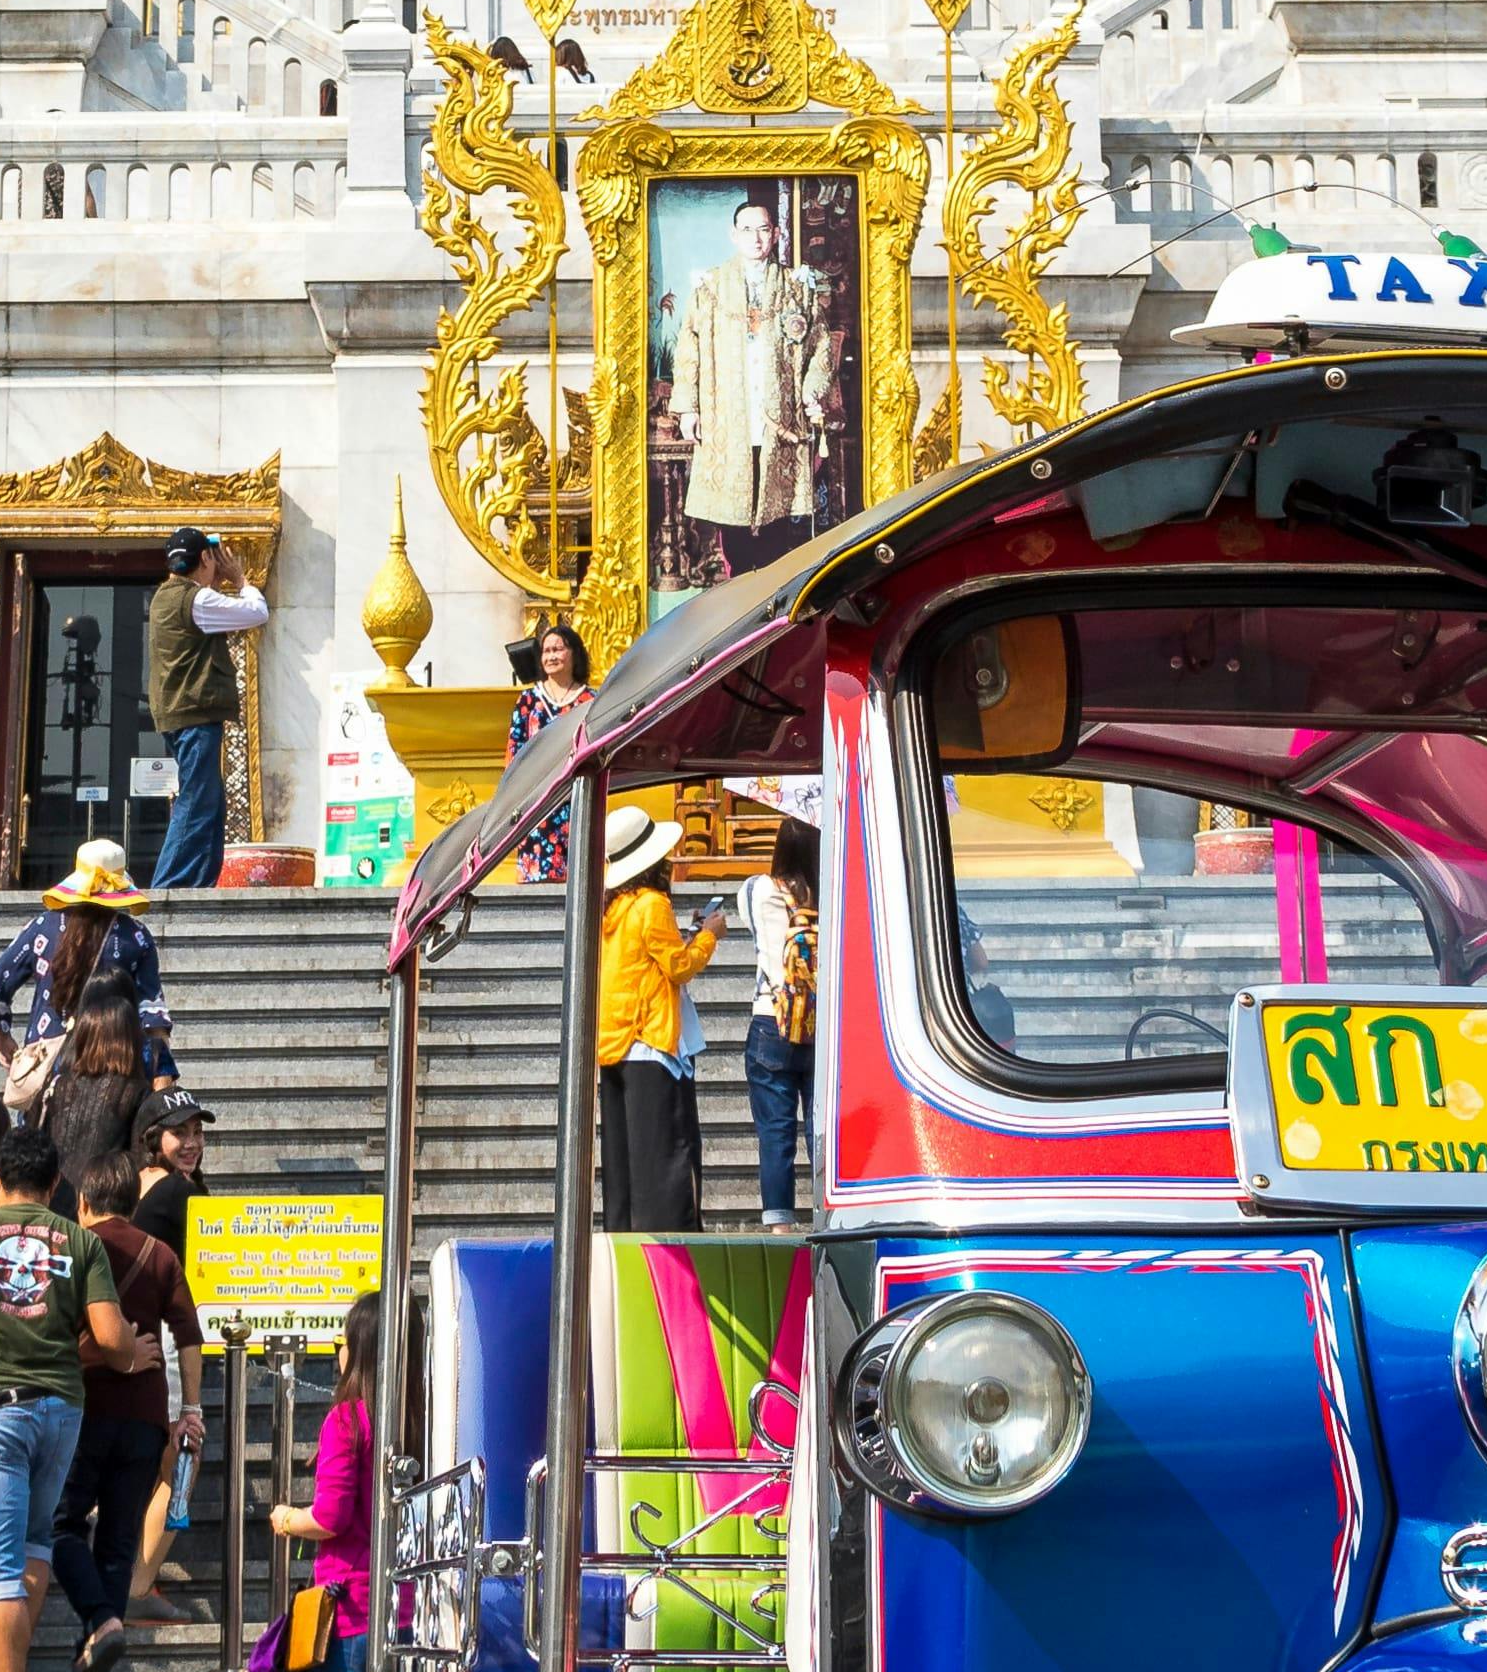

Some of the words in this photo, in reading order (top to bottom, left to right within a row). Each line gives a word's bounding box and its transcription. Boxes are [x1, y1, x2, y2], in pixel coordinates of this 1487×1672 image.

[1283, 1005, 1447, 1107] สก
[199, 1251, 235, 1261] Please
[243, 1251, 263, 1264] buy
[272, 1250, 290, 1261] the
[298, 1250, 331, 1260] ticket
[338, 1250, 376, 1260] before
[230, 1266, 254, 1276] visit
[262, 1266, 284, 1276] this
